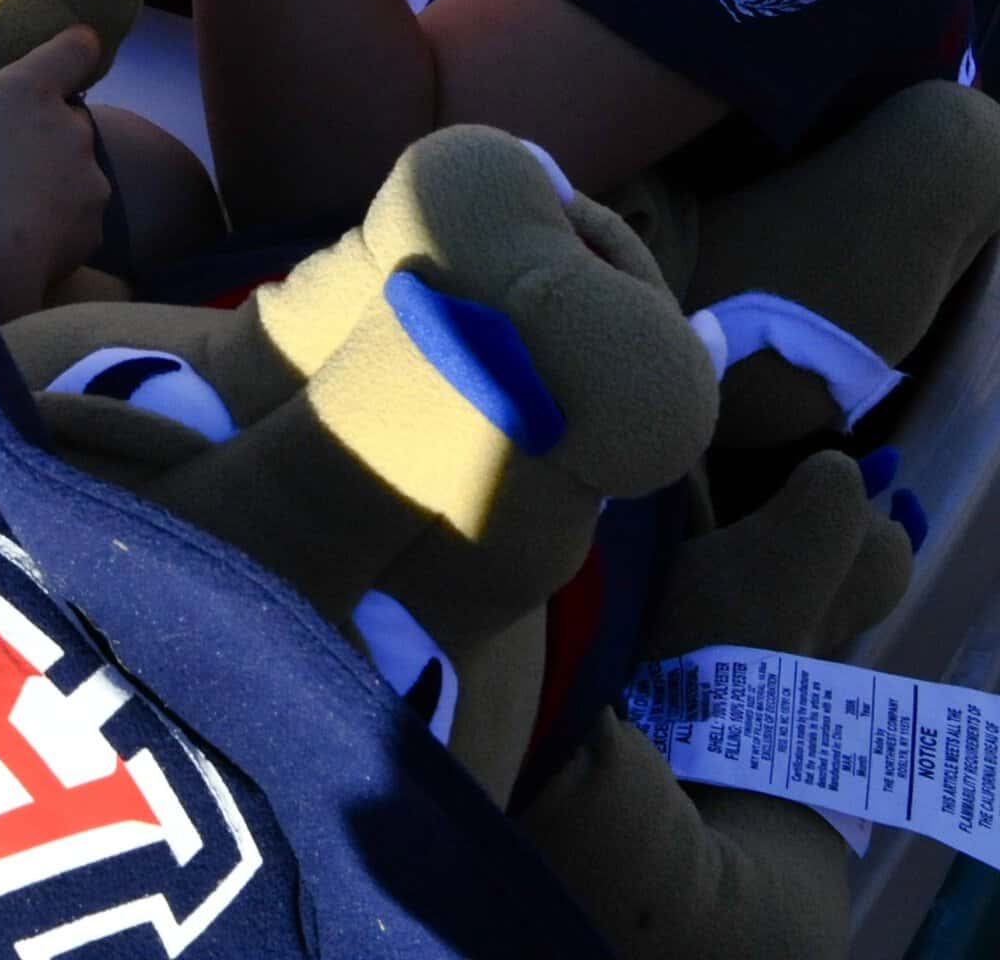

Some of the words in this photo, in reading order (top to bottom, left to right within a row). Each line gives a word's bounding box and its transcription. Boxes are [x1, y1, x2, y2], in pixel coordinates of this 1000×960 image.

[714, 662, 730, 701] POLYESTER
[732, 662, 747, 702] POLYESTER
[887, 697, 898, 732] COMPANY
[947, 707, 962, 723] THE
[968, 704, 981, 717] OF
[678, 724, 693, 744] ALL
[946, 723, 961, 738] ALL
[986, 720, 999, 734] OF
[885, 732, 897, 777] NORTHWEST
[900, 736, 909, 747] NY
[918, 726, 938, 780] NOTICE
[945, 737, 960, 763] MEETS
[964, 717, 981, 775] REQUIREMENTS
[983, 734, 998, 765] BUREAU
[883, 778, 895, 793] THE
[944, 762, 959, 797] ARTICLE
[980, 763, 997, 812] CALIFORNIA
[942, 797, 956, 815] THIS
[959, 774, 977, 834] FLAMMABILITY
[979, 810, 993, 829] THE
